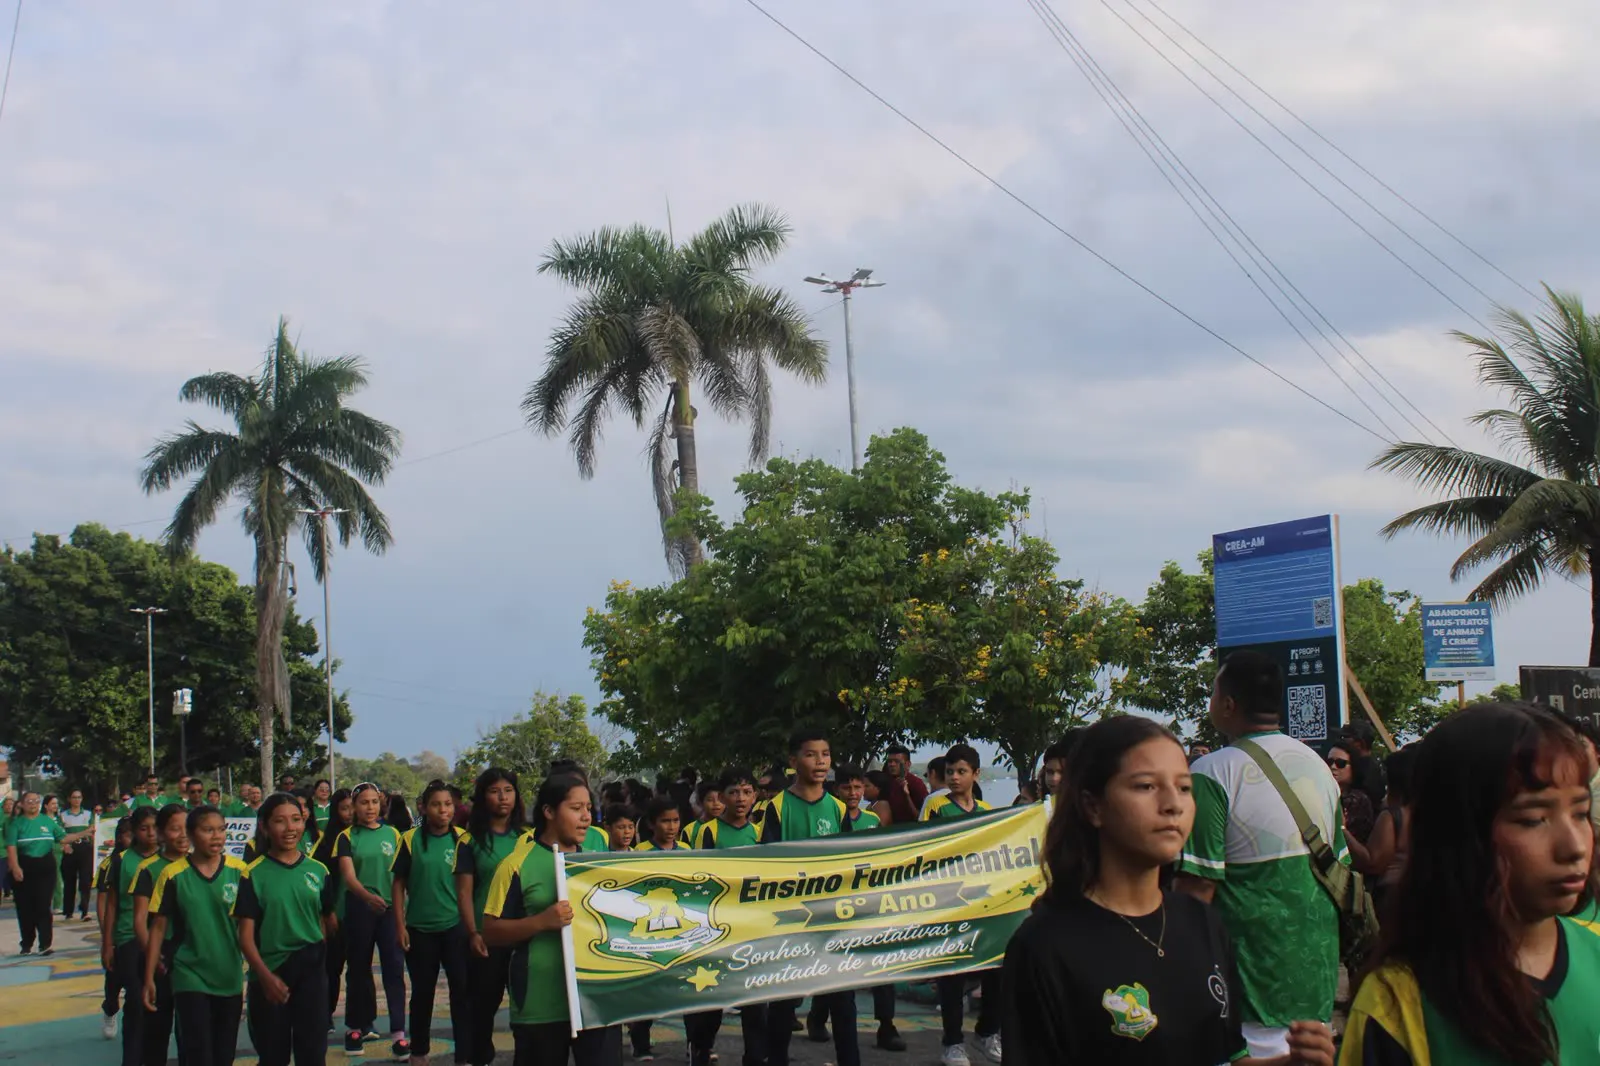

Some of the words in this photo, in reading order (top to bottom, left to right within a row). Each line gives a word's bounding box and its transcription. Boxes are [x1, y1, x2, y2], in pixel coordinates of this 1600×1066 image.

[1225, 536, 1265, 552] CREA-AM
[1426, 618, 1489, 626] MAUS-TRATOS
[1442, 636, 1448, 645] É
[225, 831, 248, 841] ÃO
[739, 871, 843, 903] Ensino
[851, 837, 1040, 890] Fundamental
[879, 891, 937, 914] Ano
[728, 940, 816, 971] Sonhos,
[824, 921, 951, 954] expectativas
[958, 921, 970, 933] e
[744, 956, 830, 989] vontade
[838, 953, 865, 972] de
[871, 931, 980, 970] aprender!
